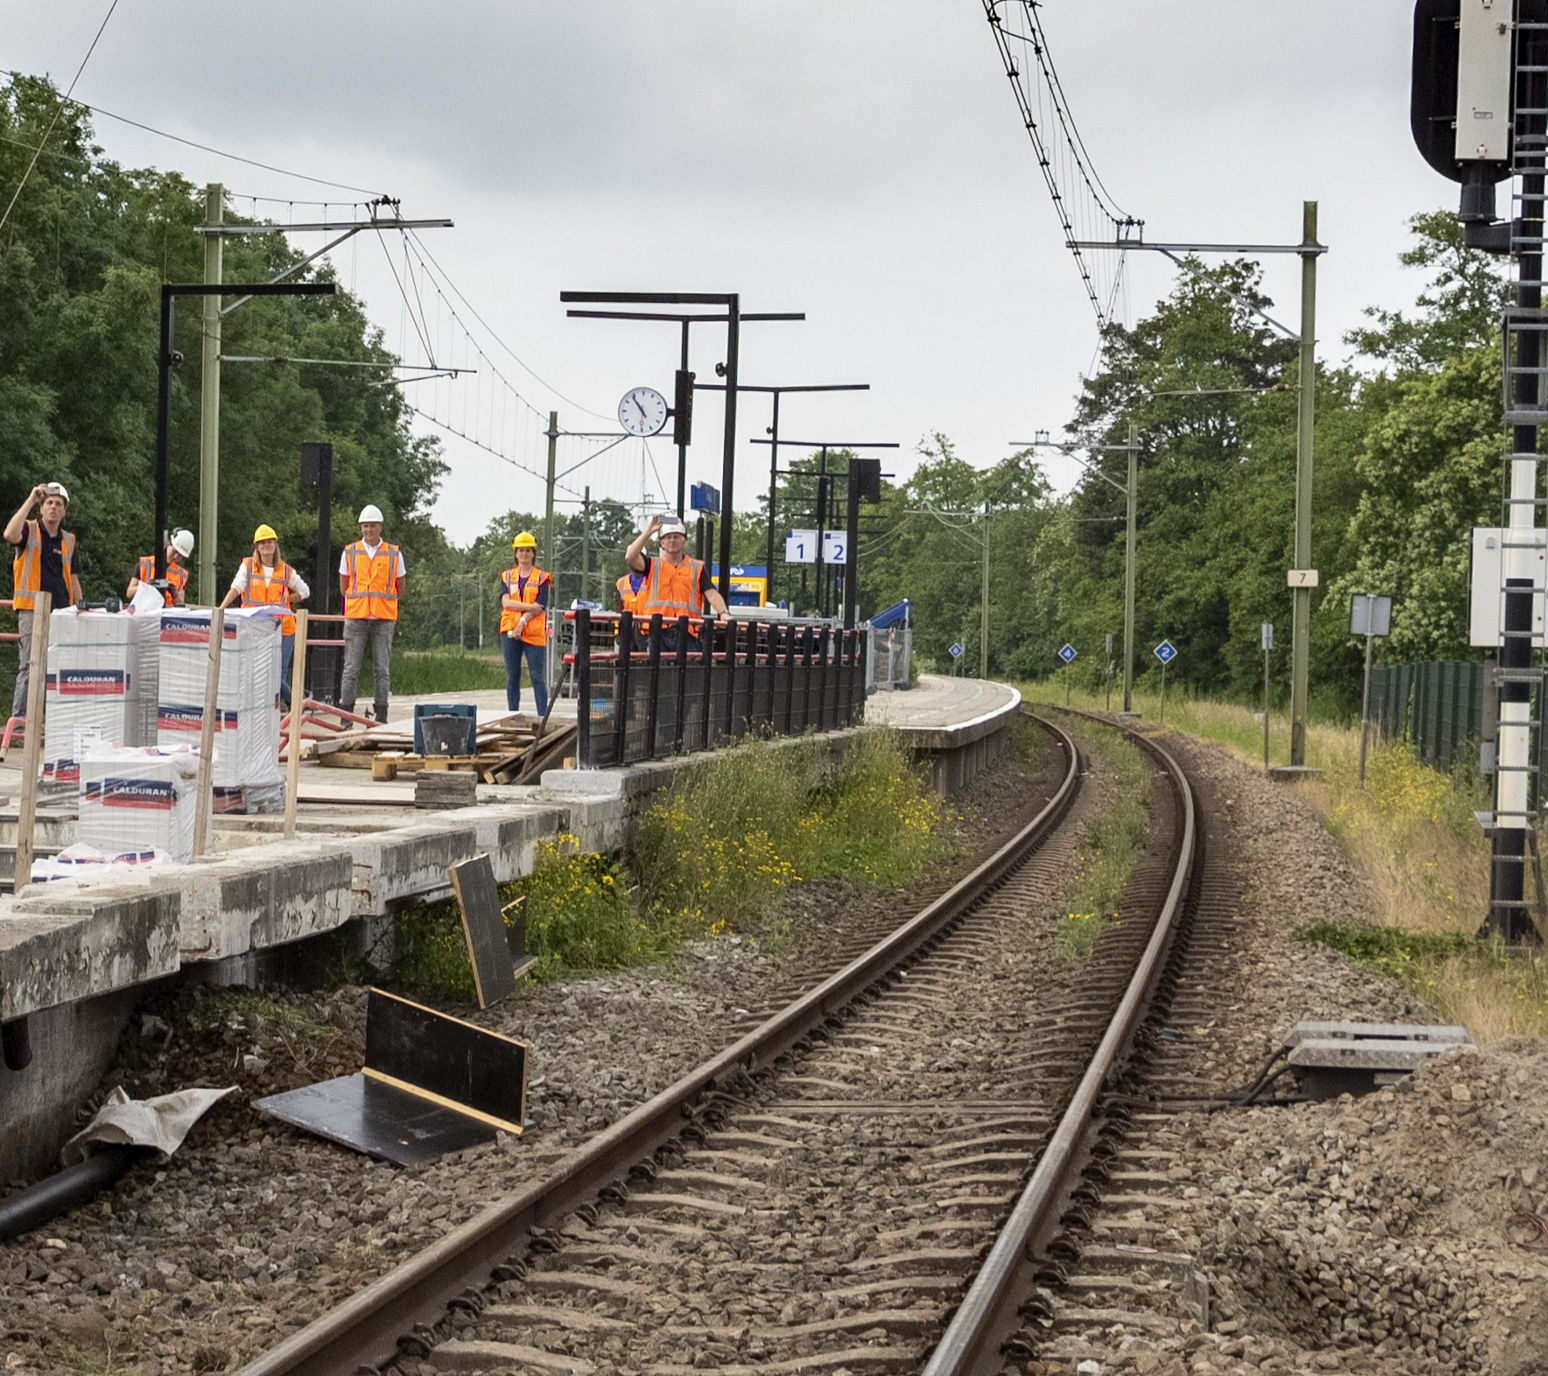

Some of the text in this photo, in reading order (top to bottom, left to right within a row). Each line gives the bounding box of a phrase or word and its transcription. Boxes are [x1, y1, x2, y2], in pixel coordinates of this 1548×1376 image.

[796, 543, 804, 559] 1
[832, 544, 844, 561] 2
[1299, 572, 1307, 584] 7
[112, 786, 168, 796] CALDURAN
